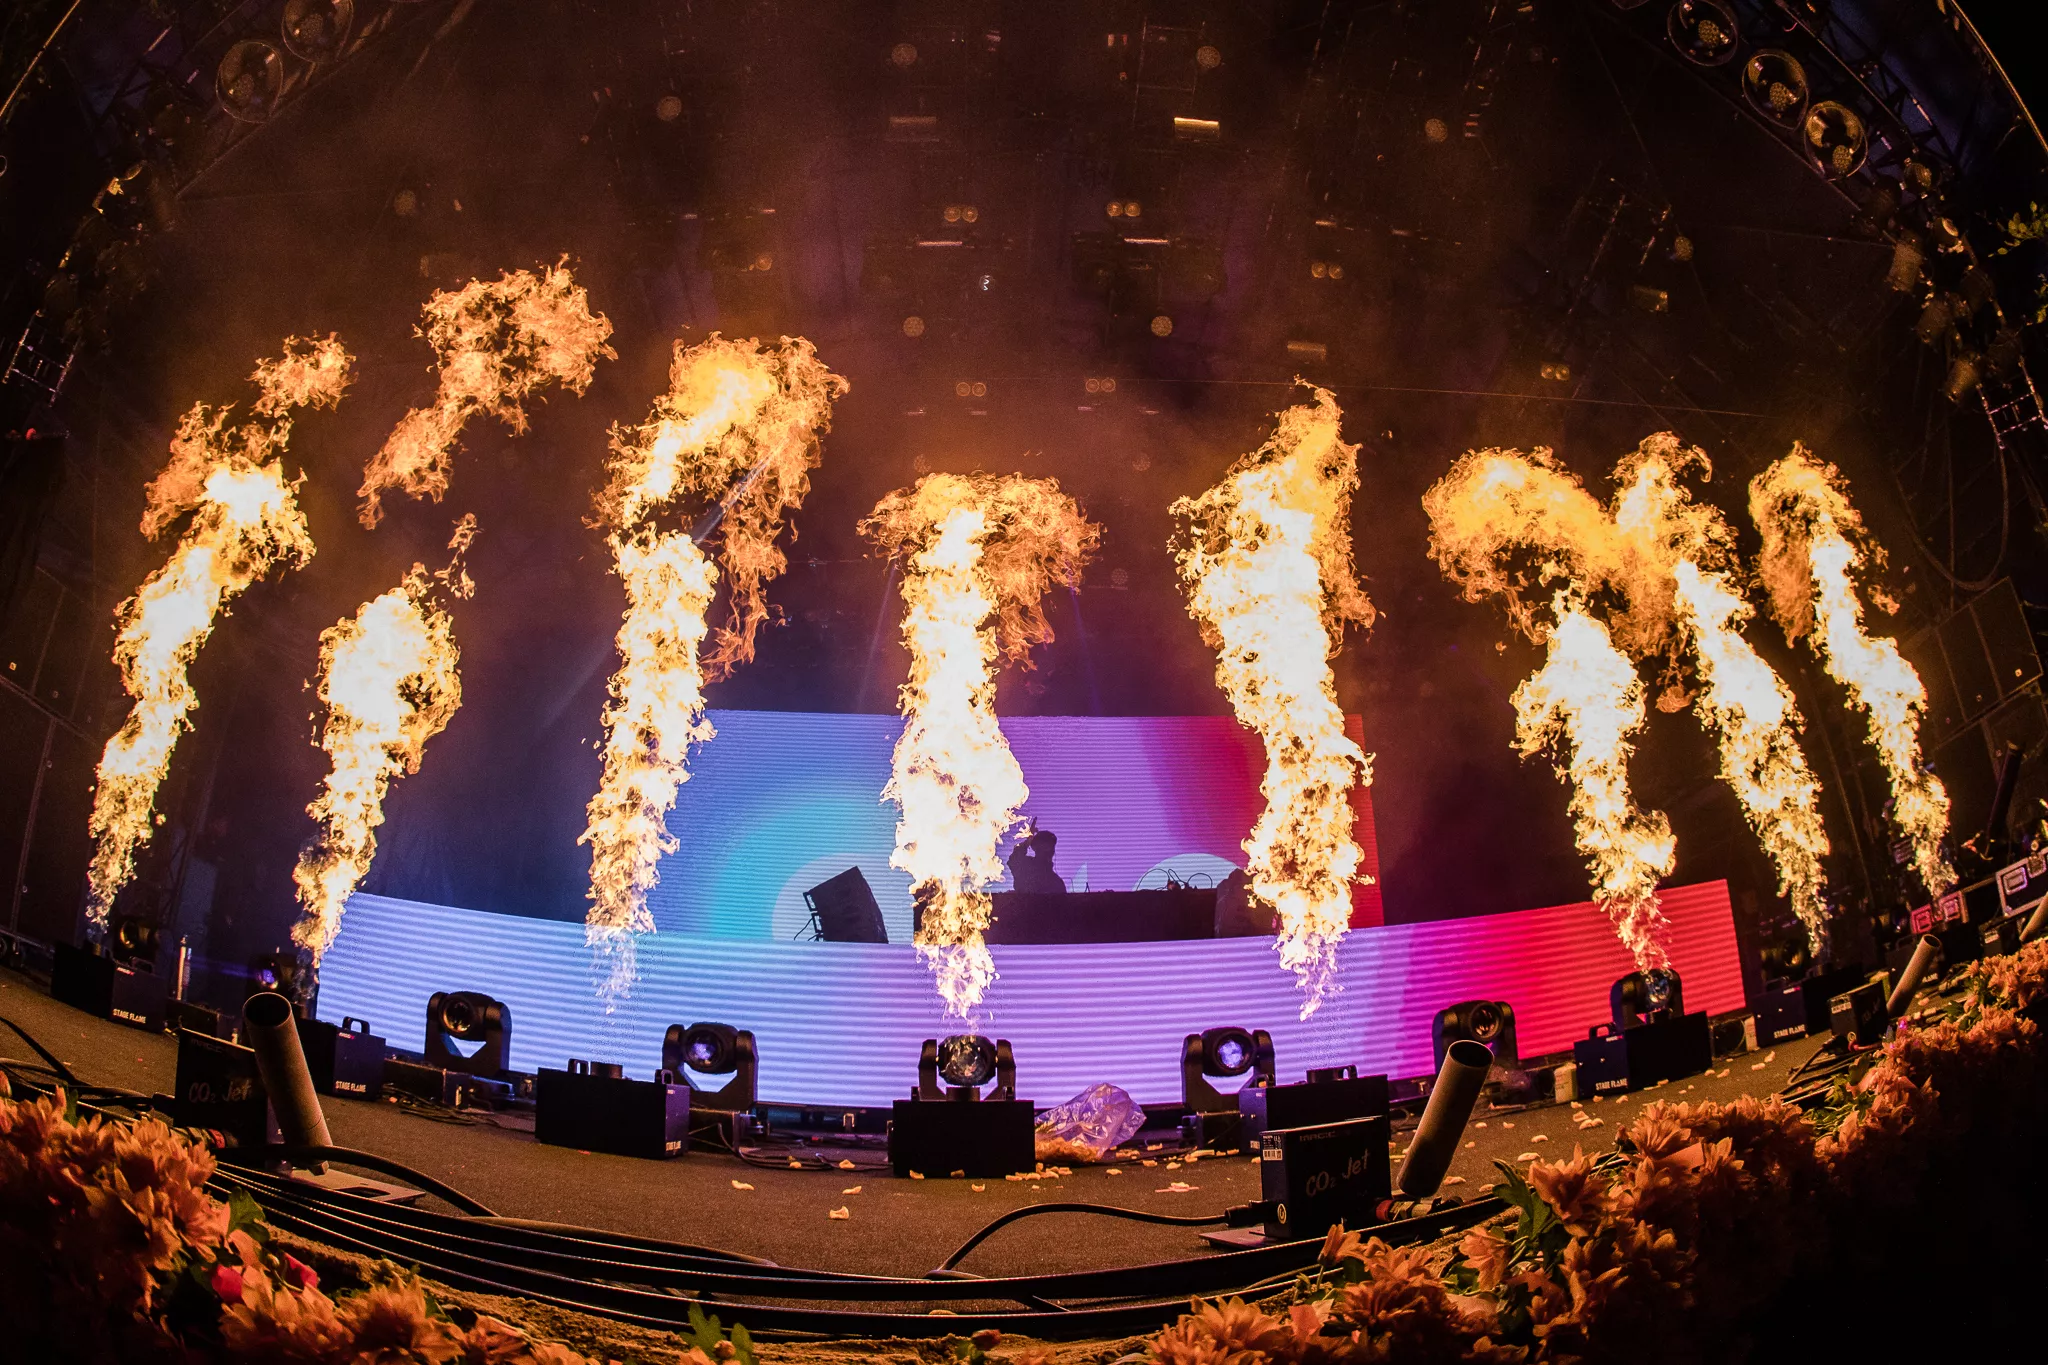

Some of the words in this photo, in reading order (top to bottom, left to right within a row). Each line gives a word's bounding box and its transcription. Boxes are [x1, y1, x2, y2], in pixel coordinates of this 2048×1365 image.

[112, 1008, 129, 1020] STAGE
[129, 1012, 147, 1024] FLAME
[1773, 1028, 1789, 1039] STAGE
[1789, 1024, 1806, 1035] FLAME
[222, 1078, 252, 1102] Jet
[335, 1080, 350, 1090] STAGE
[351, 1082, 367, 1093] FLAME
[1595, 1081, 1610, 1091] STAGE
[1611, 1077, 1628, 1088] FLAME
[1341, 1148, 1372, 1180] Jet
